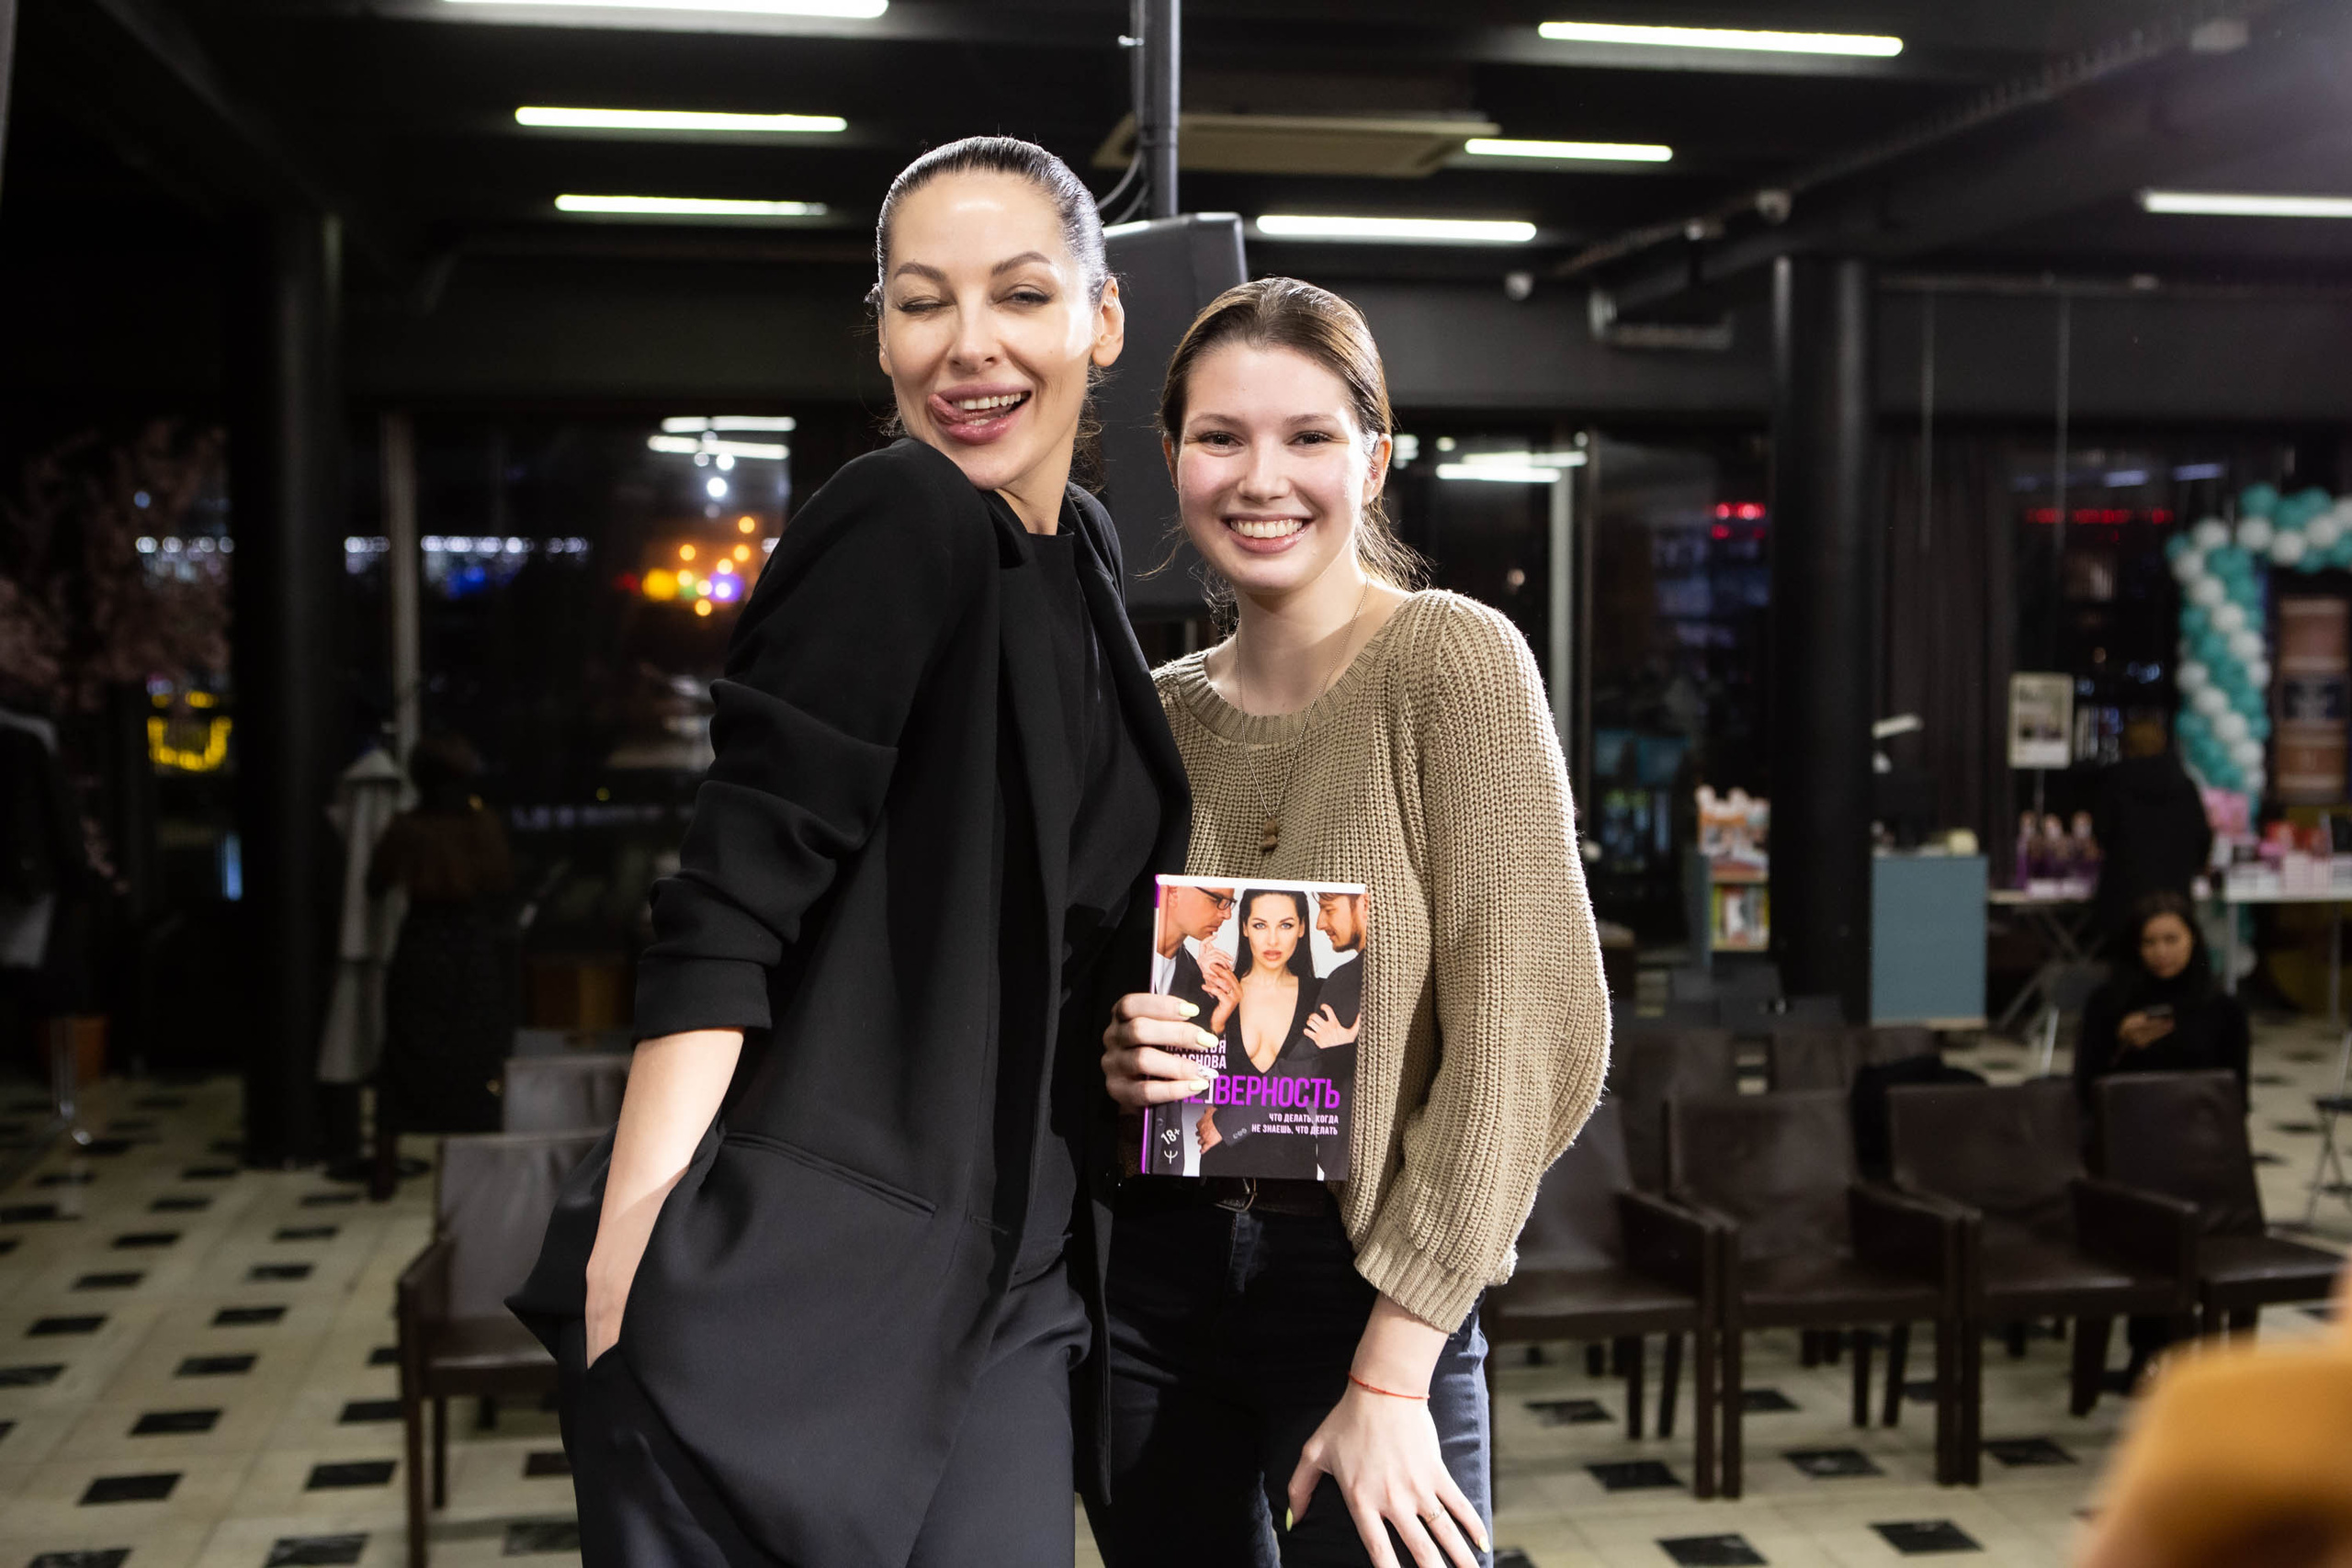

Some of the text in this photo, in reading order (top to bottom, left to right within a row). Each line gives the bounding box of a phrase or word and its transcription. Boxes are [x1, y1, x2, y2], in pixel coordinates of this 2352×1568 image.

[1173, 1054, 1227, 1069] НОВА
[1269, 1112, 1283, 1122] ЧТО
[1315, 1114, 1339, 1124] КОГДА
[1251, 1123, 1339, 1135] НЕ ЗНАЕШЬ, ЧТО ДЕЛАТЬ
[1160, 1128, 1181, 1145] 18+
